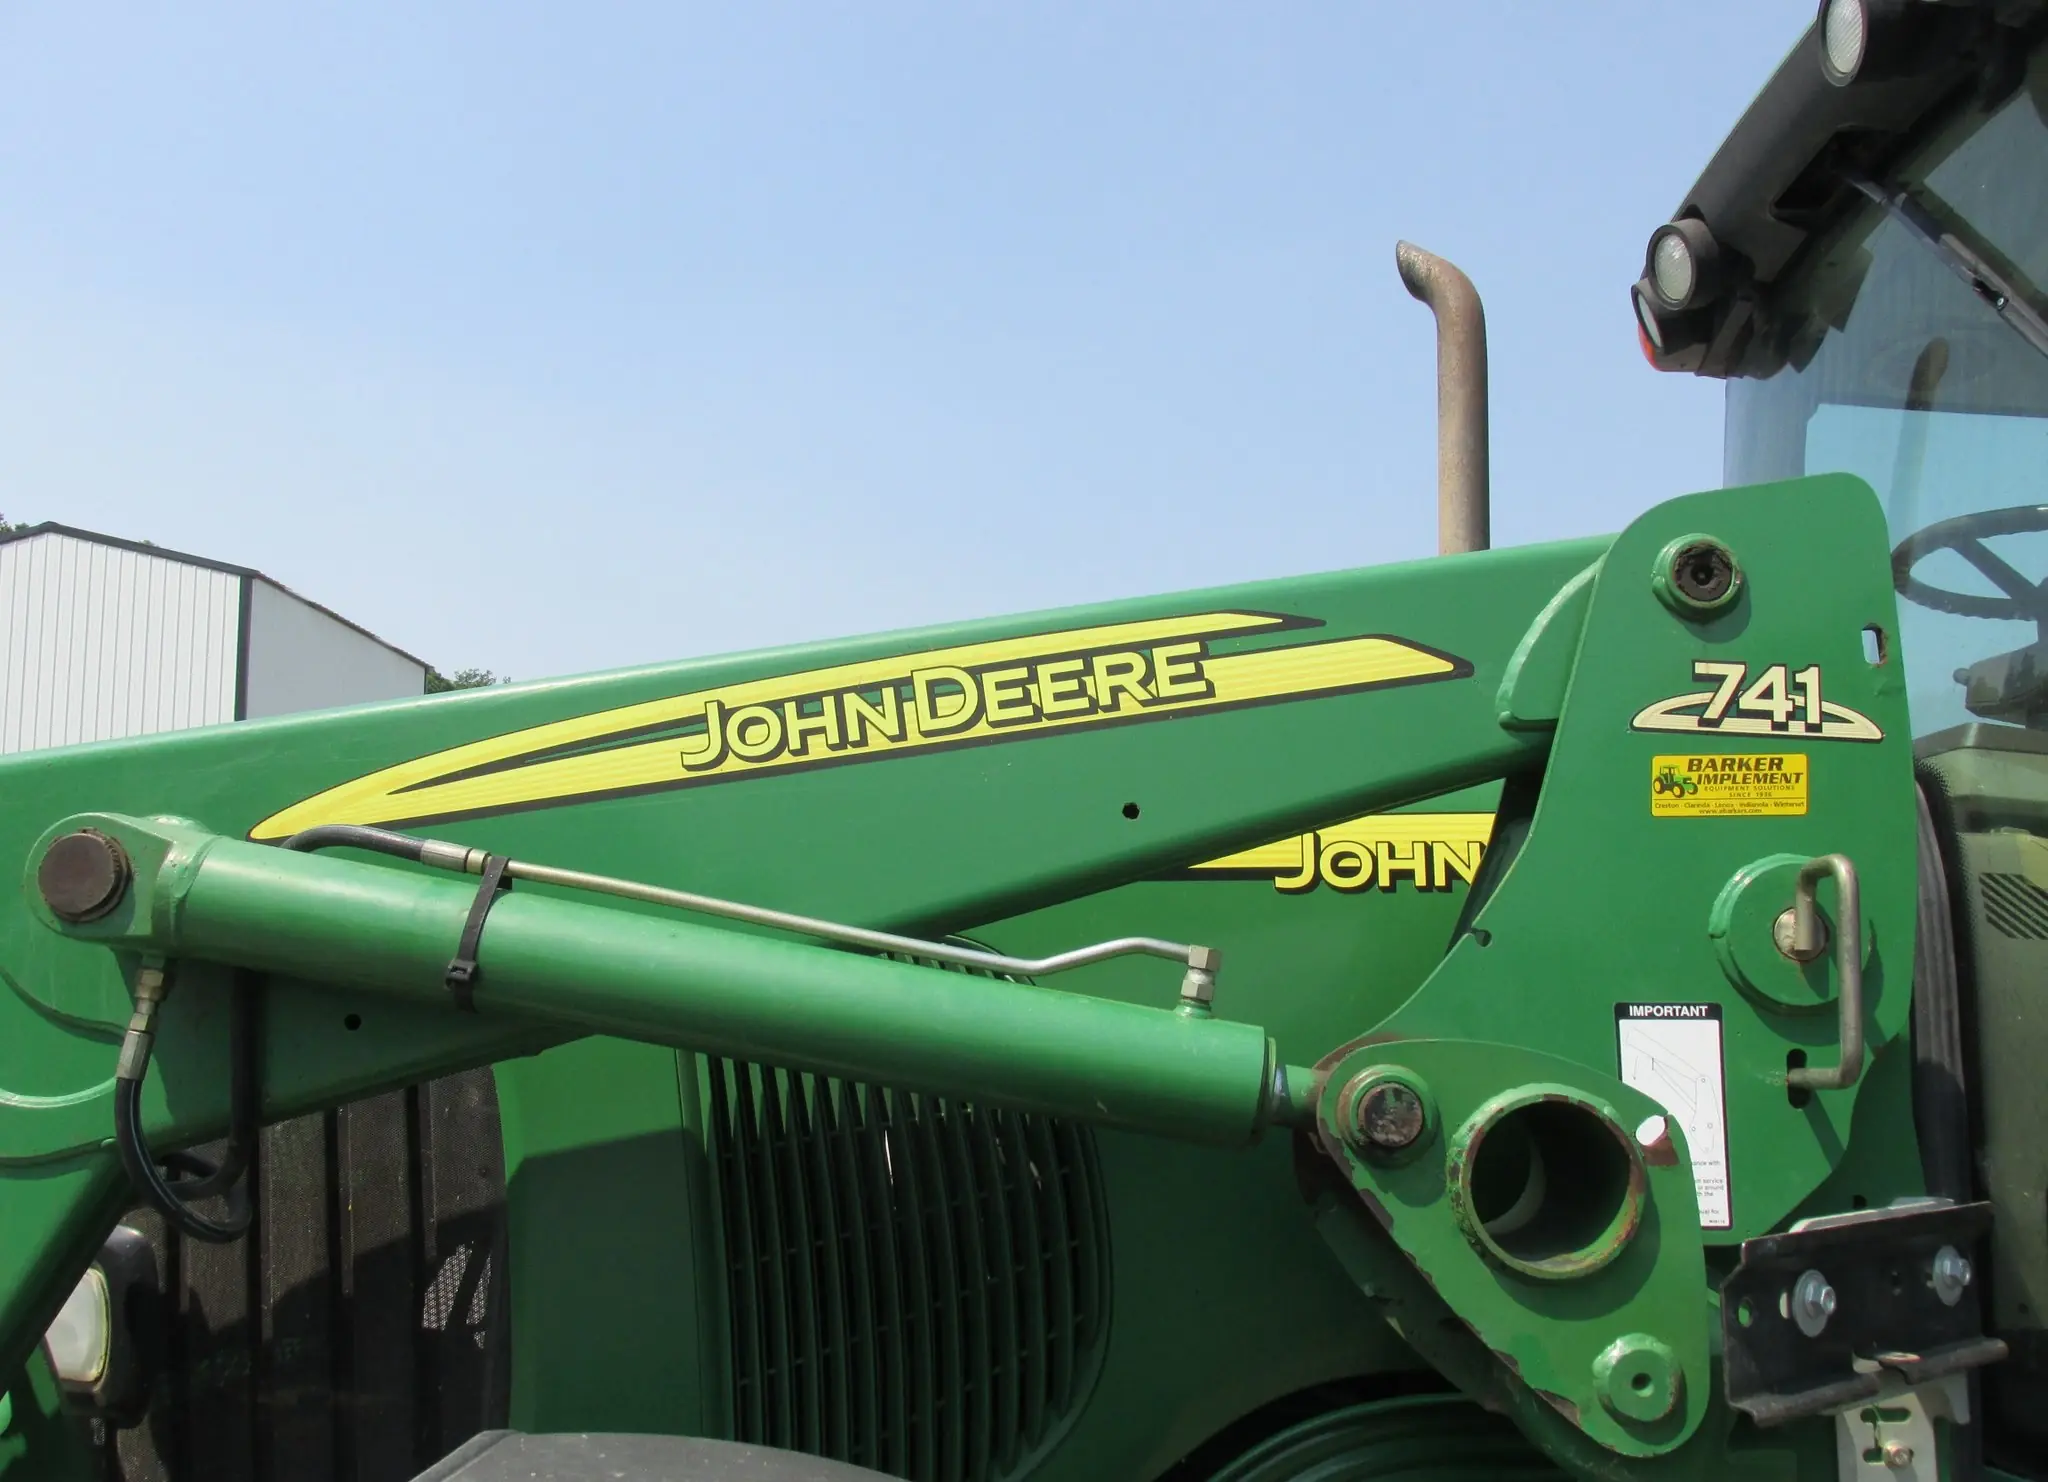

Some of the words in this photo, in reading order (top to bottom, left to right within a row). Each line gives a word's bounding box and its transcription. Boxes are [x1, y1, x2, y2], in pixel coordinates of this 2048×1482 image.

[1692, 660, 1823, 733] 741
[680, 686, 906, 772] JOHN
[910, 641, 1215, 737] DEERE
[1687, 757, 1784, 772] BARKER
[1697, 771, 1804, 786] IMPLEMENT
[1629, 1005, 1708, 1018] IMPORTANT
